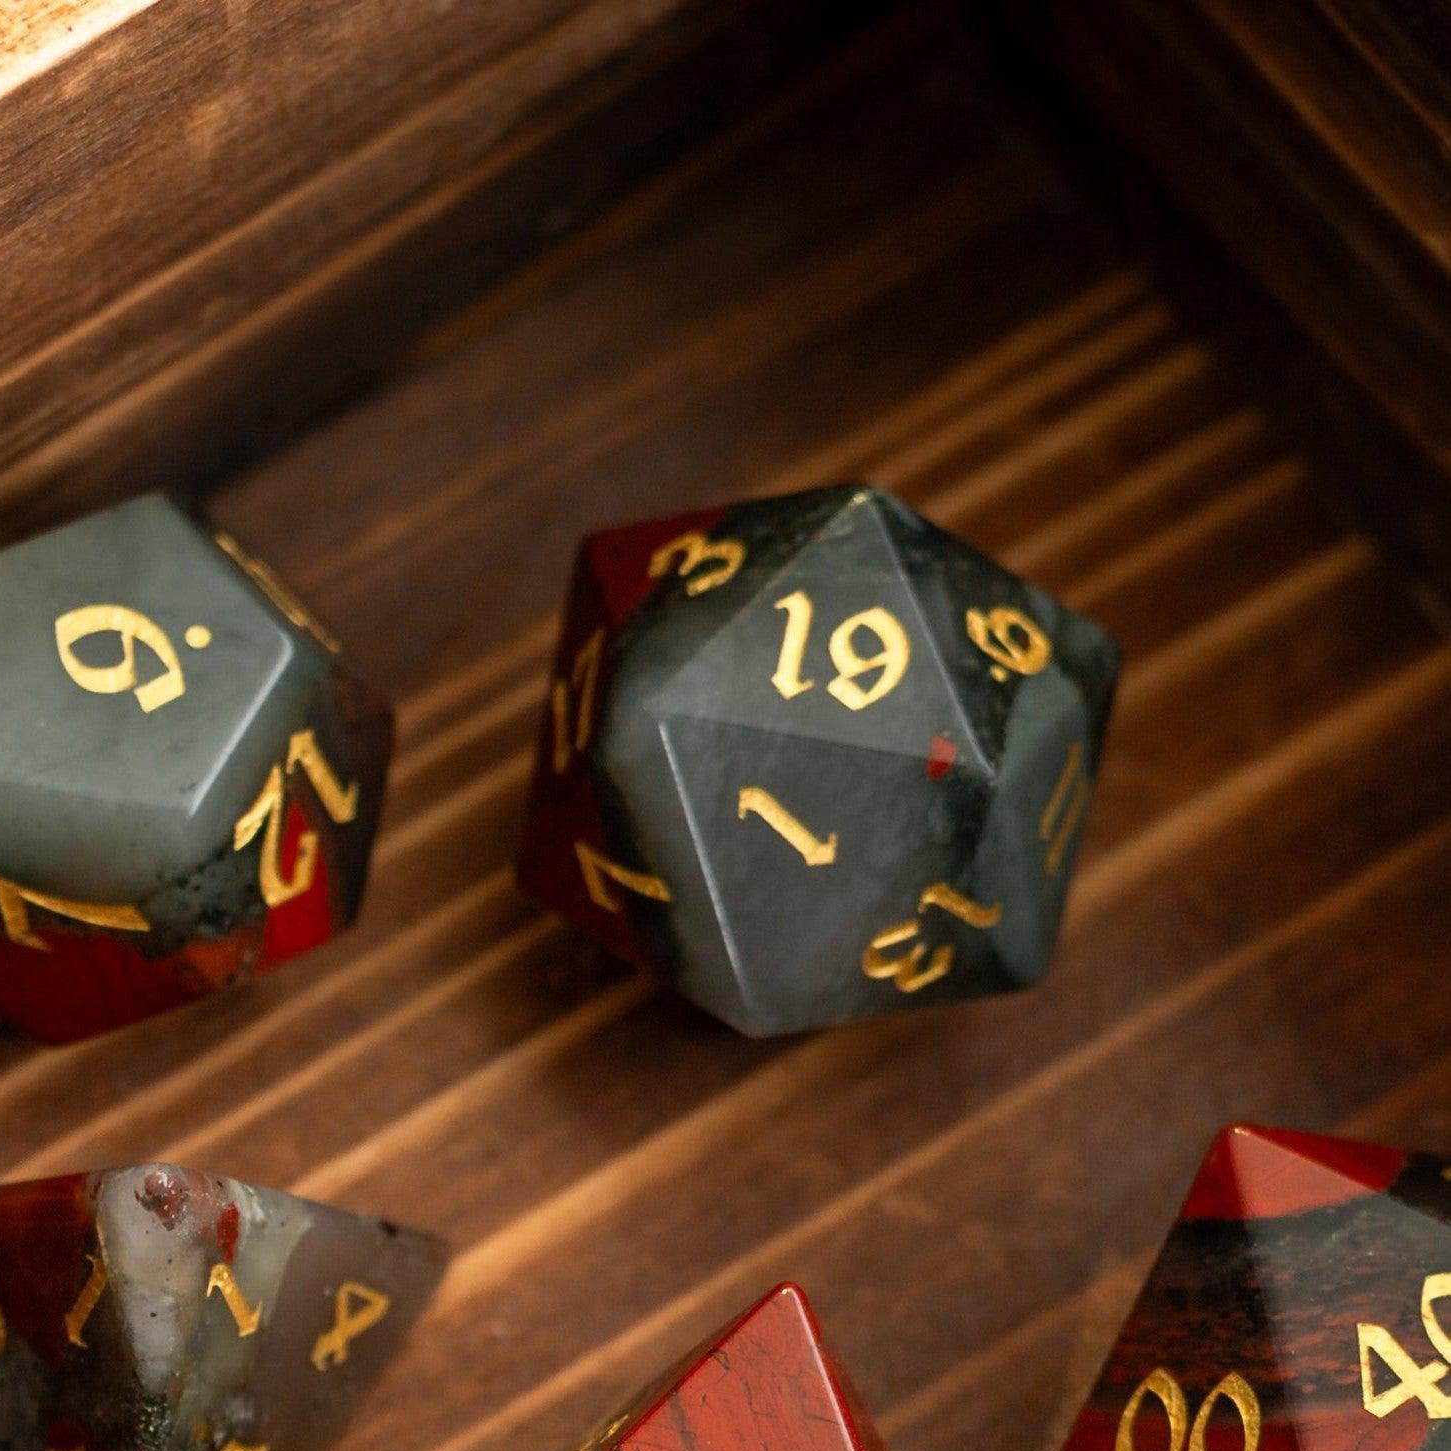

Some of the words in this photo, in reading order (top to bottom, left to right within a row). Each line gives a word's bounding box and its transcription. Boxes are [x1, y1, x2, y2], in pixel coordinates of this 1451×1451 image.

[649, 531, 745, 597] 3
[771, 591, 910, 711] 19
[234, 730, 359, 907] 12
[739, 787, 837, 866] 1
[574, 842, 671, 912] 7
[862, 883, 1003, 993] 13
[64, 1254, 109, 1348] 1
[207, 1263, 262, 1336] 1
[310, 1281, 388, 1371] 4
